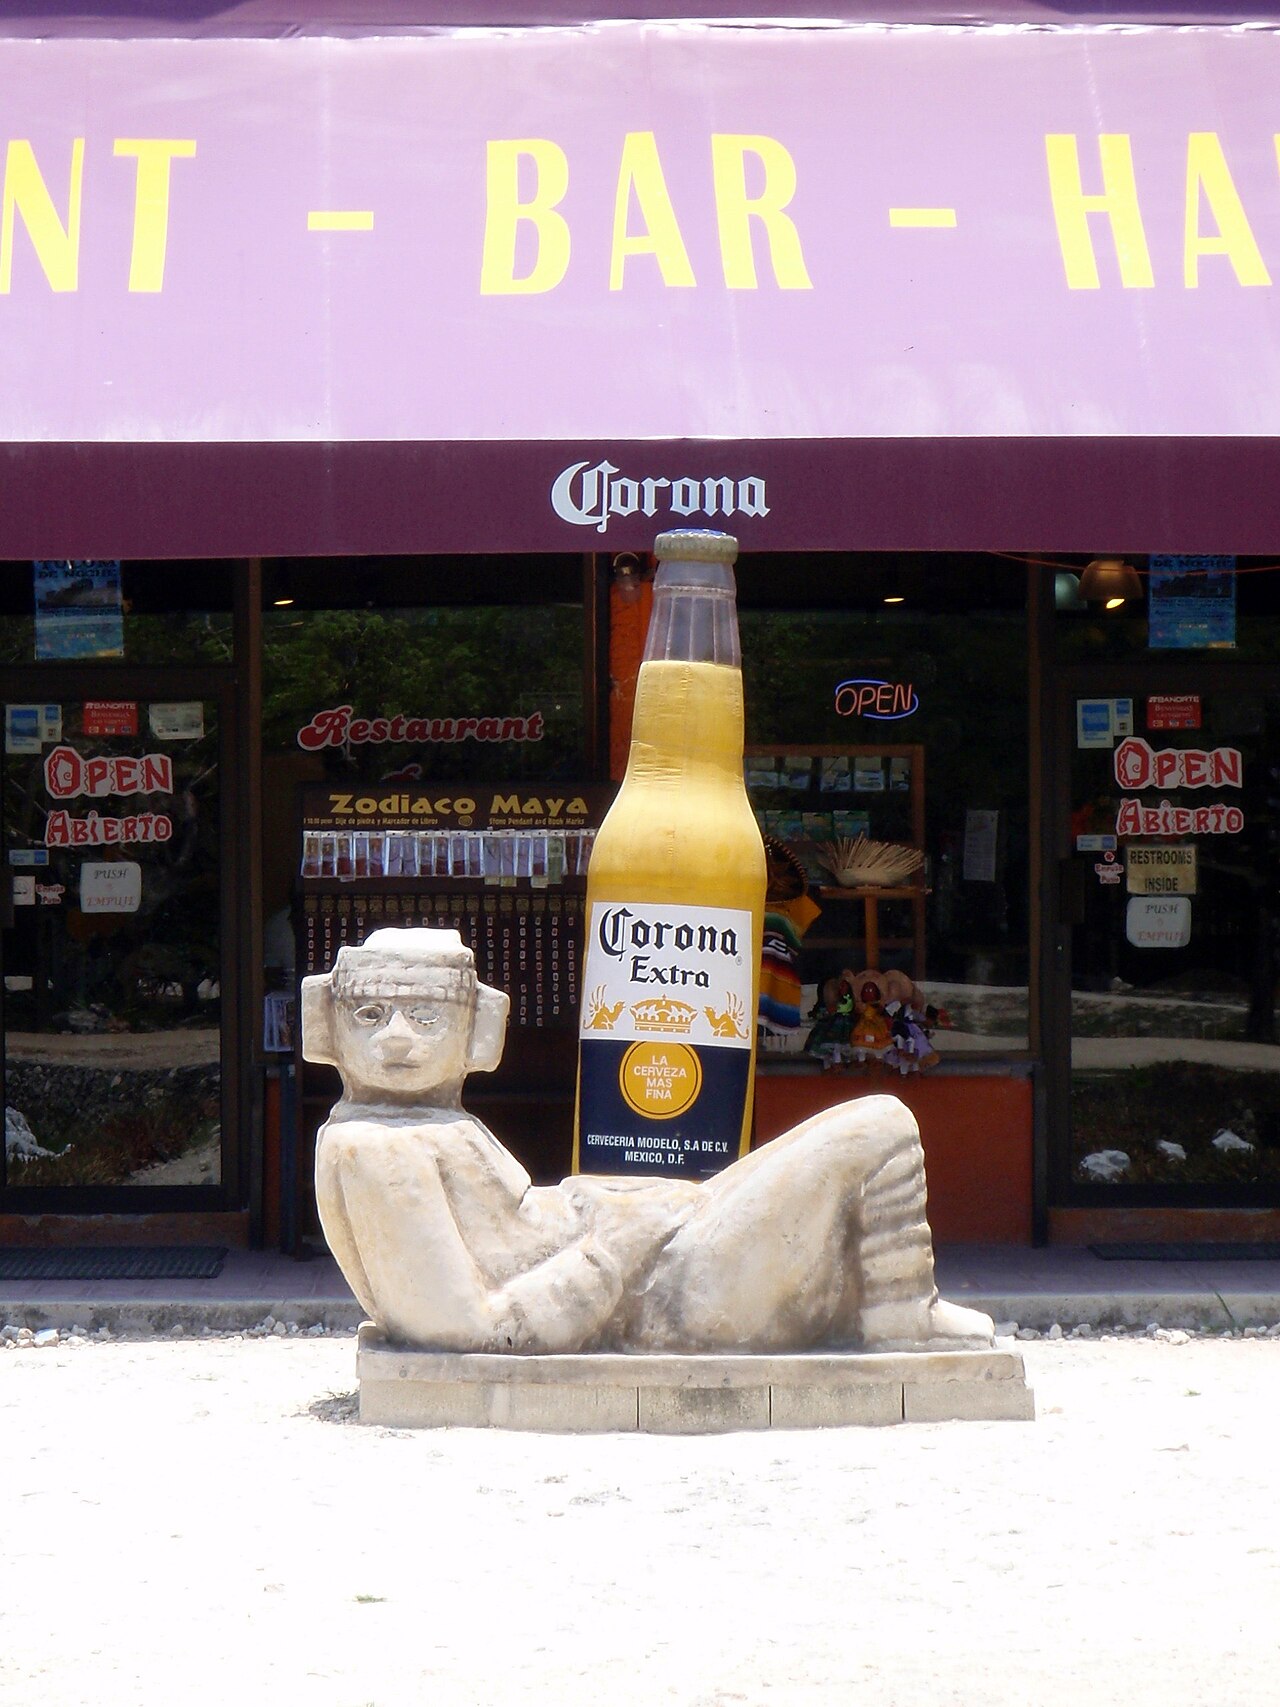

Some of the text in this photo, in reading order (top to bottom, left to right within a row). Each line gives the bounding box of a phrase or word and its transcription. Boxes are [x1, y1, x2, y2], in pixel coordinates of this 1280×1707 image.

[0, 138, 196, 293] NT
[480, 132, 813, 295] BAR
[1045, 132, 1280, 289] HA
[551, 459, 770, 533] Corona
[835, 684, 913, 716] OPEN
[298, 706, 543, 750] Restaurant
[329, 794, 589, 817] Zodiaco Maya
[1130, 851, 1192, 864] RESTROOMS
[94, 868, 127, 880] PUSH
[1145, 877, 1178, 892] INSIDE
[1145, 903, 1179, 914] PUSH
[599, 907, 739, 961] Corona
[630, 955, 711, 988] Extra
[652, 1055, 668, 1067] LA
[633, 1065, 687, 1078] CERVEZA
[646, 1077, 673, 1089] MAS
[645, 1089, 672, 1100] FINA
[587, 1134, 635, 1148] CERVECERIA
[637, 1136, 681, 1152] MODELO,
[701, 1141, 714, 1152] DE
[624, 1150, 685, 1165] MEXICO, D.F.
